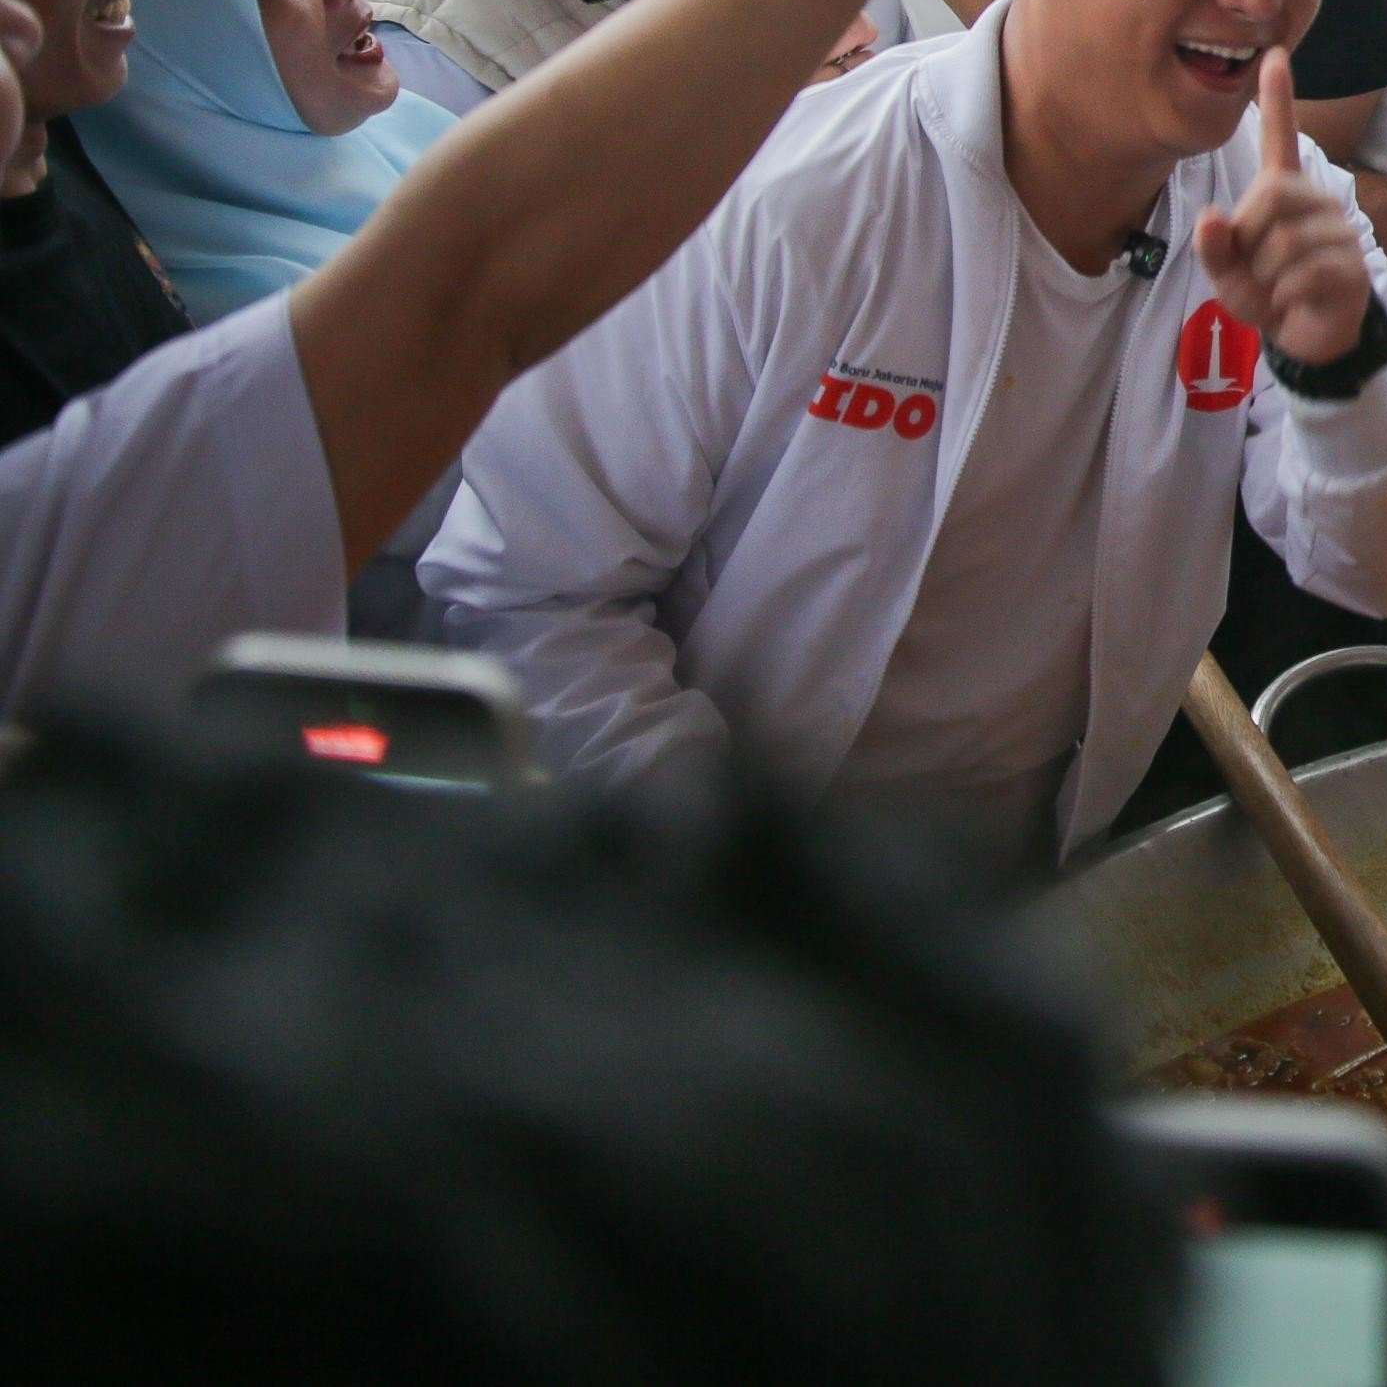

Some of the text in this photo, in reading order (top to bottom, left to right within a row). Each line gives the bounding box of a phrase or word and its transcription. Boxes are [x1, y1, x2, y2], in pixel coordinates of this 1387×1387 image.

[840, 363, 944, 393] Baru Jakarta Maju
[808, 373, 936, 441] IDO
